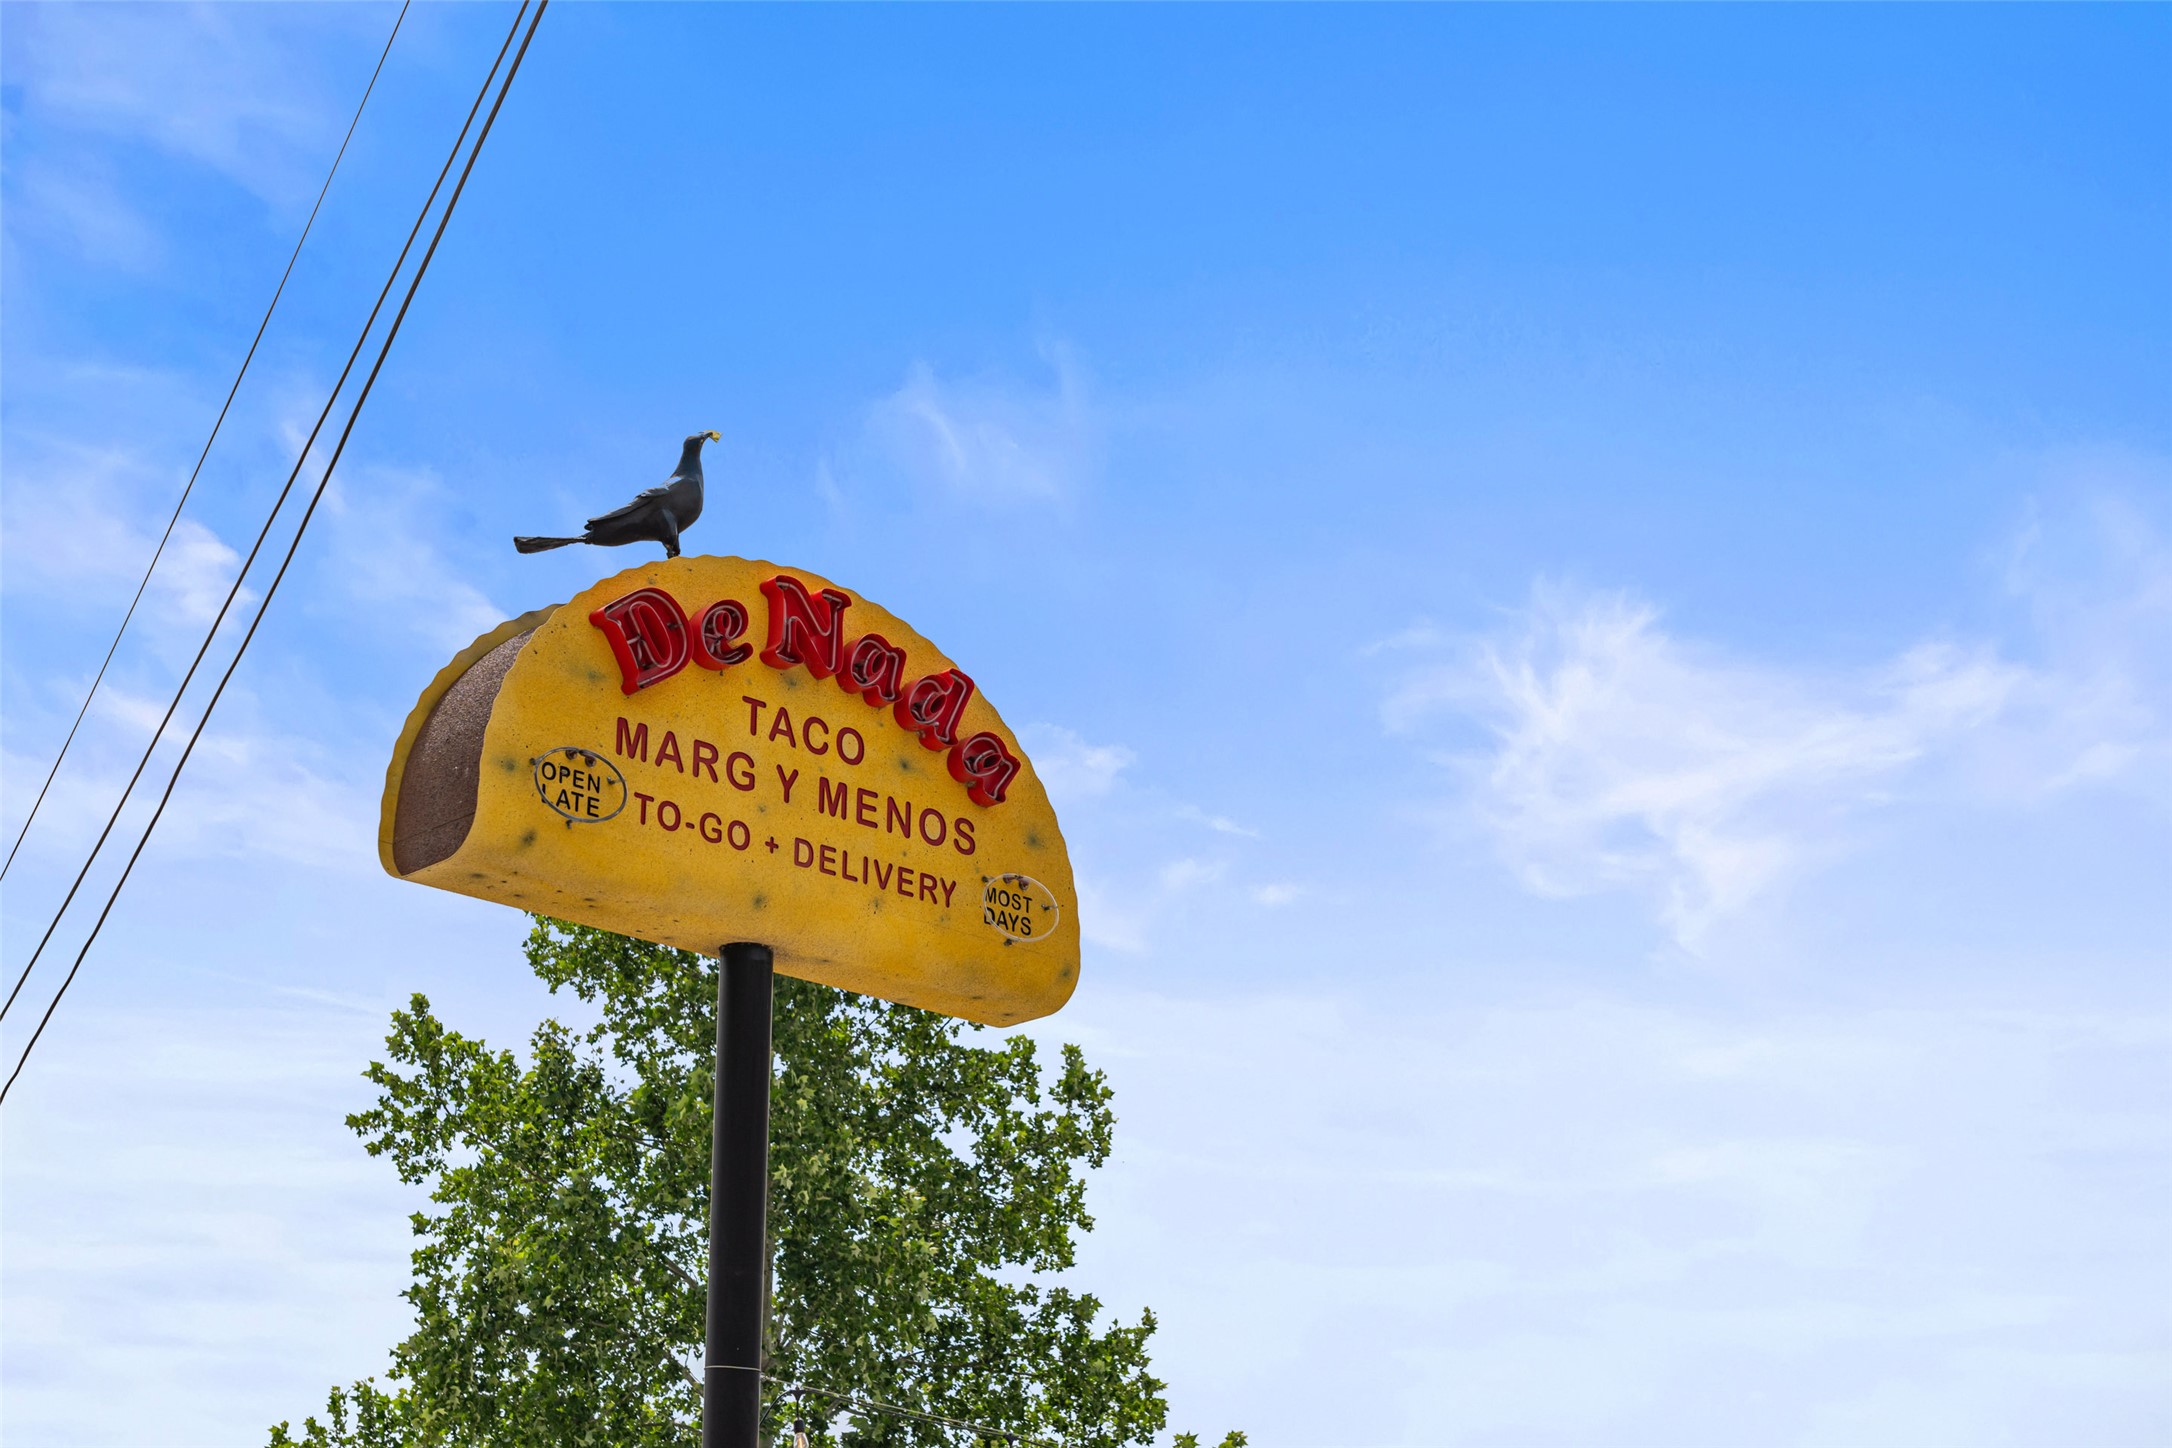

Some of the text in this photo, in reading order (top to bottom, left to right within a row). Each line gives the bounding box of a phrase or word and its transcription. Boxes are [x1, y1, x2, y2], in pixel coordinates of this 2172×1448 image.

[742, 695, 865, 766] TACO
[541, 761, 600, 794] OPEN
[615, 717, 977, 856] MARG Y MENOS
[634, 792, 751, 851] TO-GO
[794, 837, 957, 908] DELIVERY
[984, 906, 1032, 936] DAYS
[985, 887, 1033, 914] MOST
